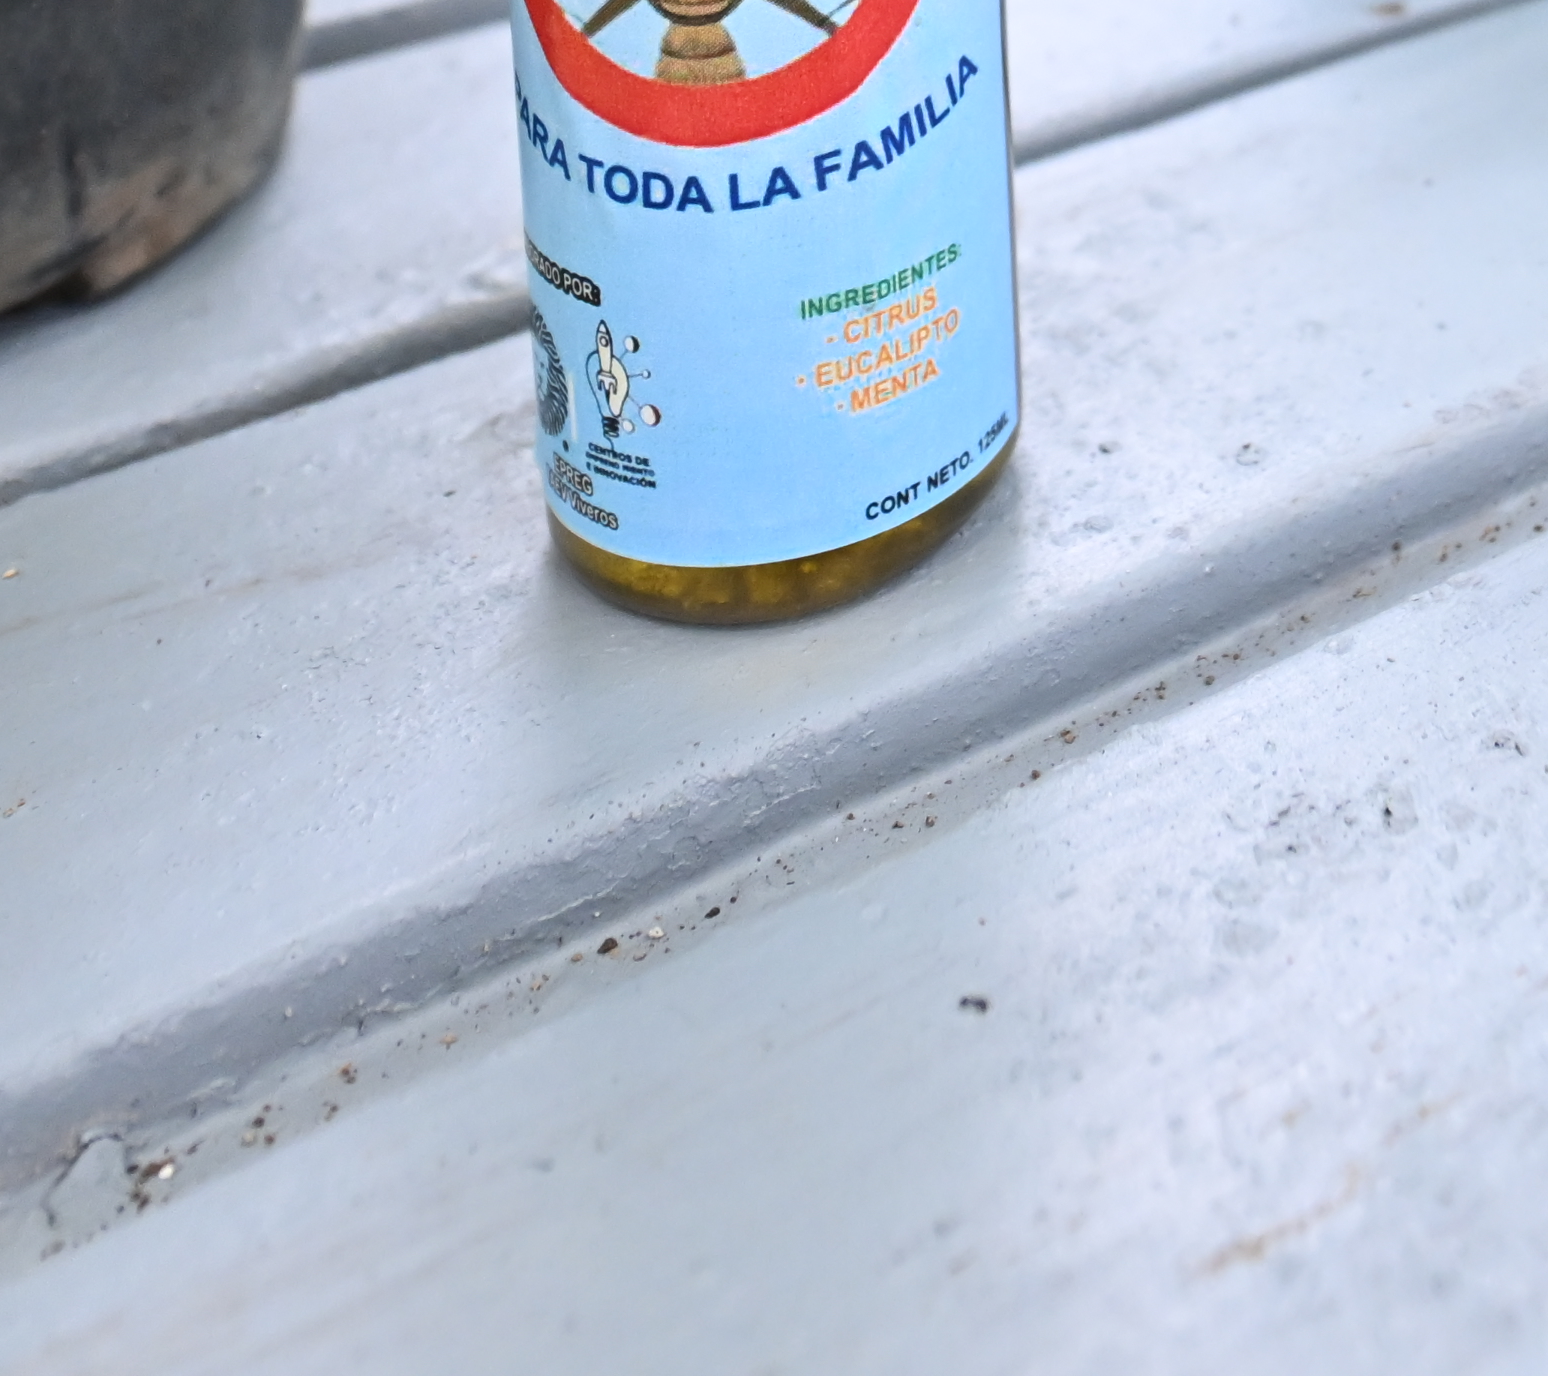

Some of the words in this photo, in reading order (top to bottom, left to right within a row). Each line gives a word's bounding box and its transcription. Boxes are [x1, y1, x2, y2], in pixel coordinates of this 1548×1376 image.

[578, 153, 714, 213] TODA
[729, 166, 801, 211] LA
[814, 55, 978, 191] FAMILIA
[563, 273, 598, 302] POR:
[800, 243, 962, 320] INGREDIENTES:
[843, 286, 938, 344] CITRUS
[814, 307, 961, 388] EUCALIPTO
[850, 358, 941, 413] MENTA
[570, 491, 619, 529] Viveros
[865, 481, 920, 520] CONT
